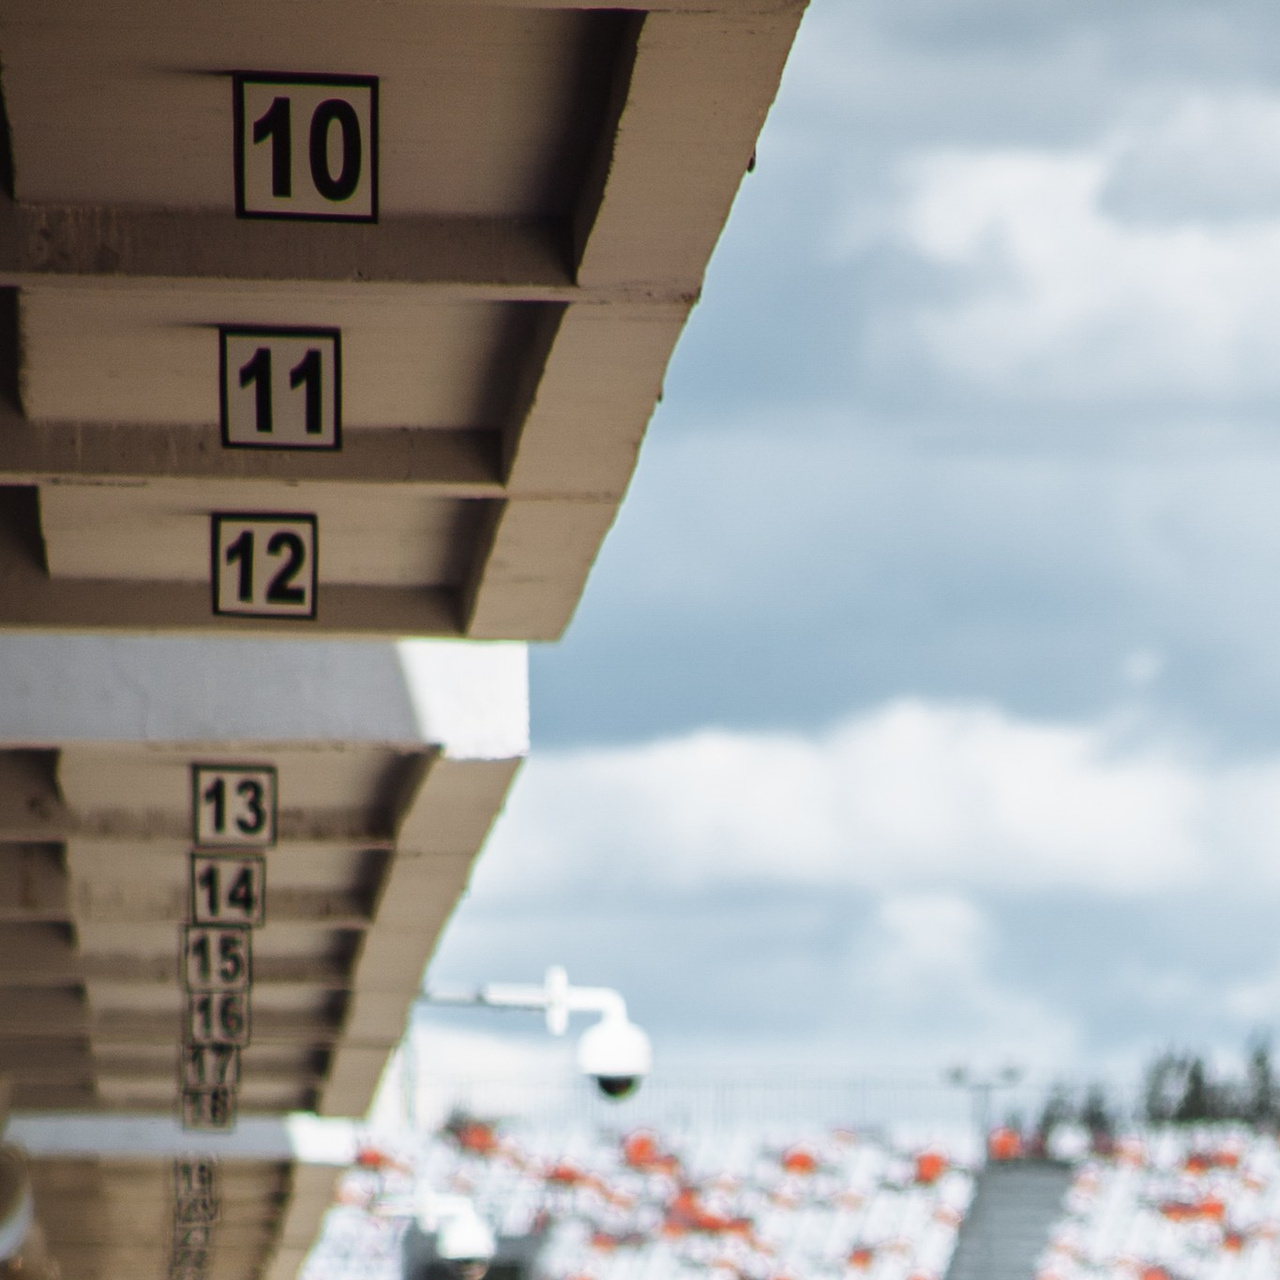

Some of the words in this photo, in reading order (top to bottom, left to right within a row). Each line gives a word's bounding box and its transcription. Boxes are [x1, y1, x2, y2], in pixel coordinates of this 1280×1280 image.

[252, 96, 362, 202] 10
[238, 347, 323, 434] 11
[225, 530, 307, 605] 12
[203, 777, 267, 835] 13
[201, 866, 258, 917] 14
[195, 937, 244, 983] 15
[195, 994, 244, 1038] 16
